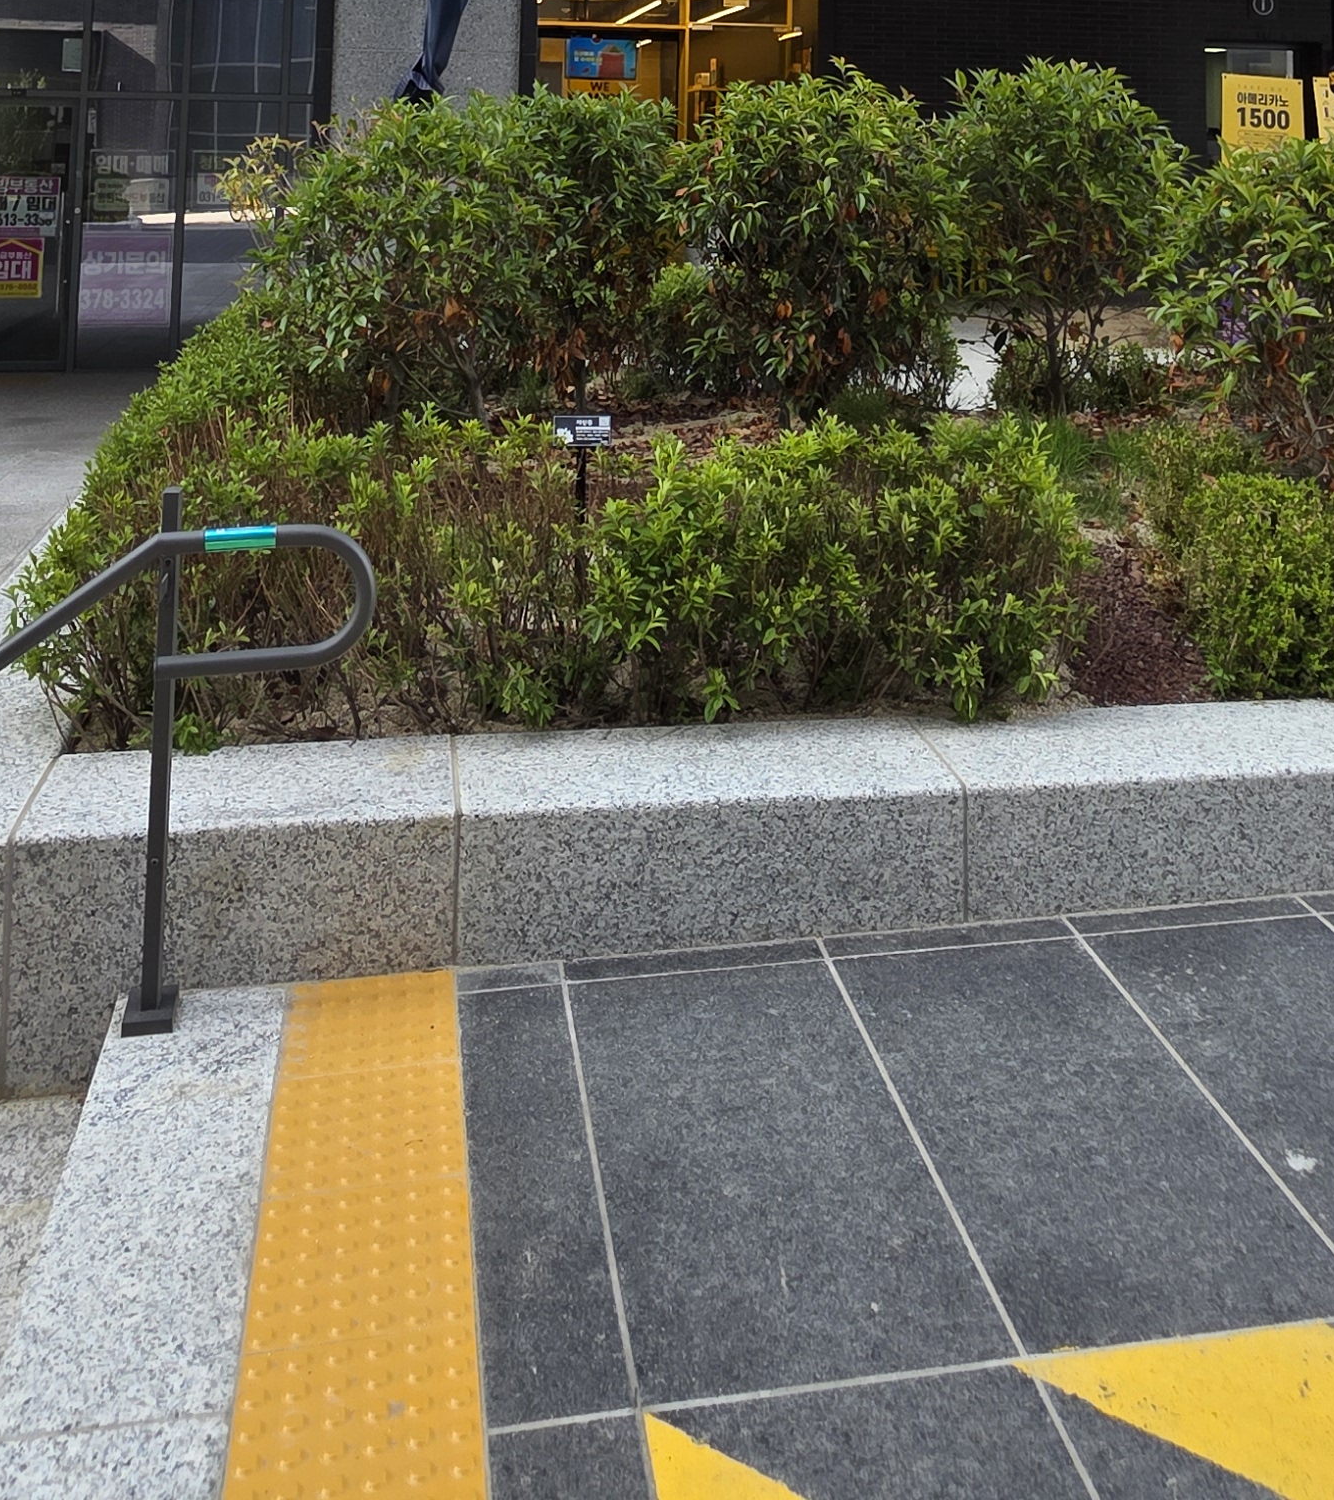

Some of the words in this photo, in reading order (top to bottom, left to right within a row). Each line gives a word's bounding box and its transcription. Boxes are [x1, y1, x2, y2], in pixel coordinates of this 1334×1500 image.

[590, 82, 610, 91] WE
[1236, 91, 1290, 108] 아메리카노
[1236, 106, 1291, 130] 1500
[83, 250, 166, 275] 상가문의
[80, 288, 165, 310] 378-3324
